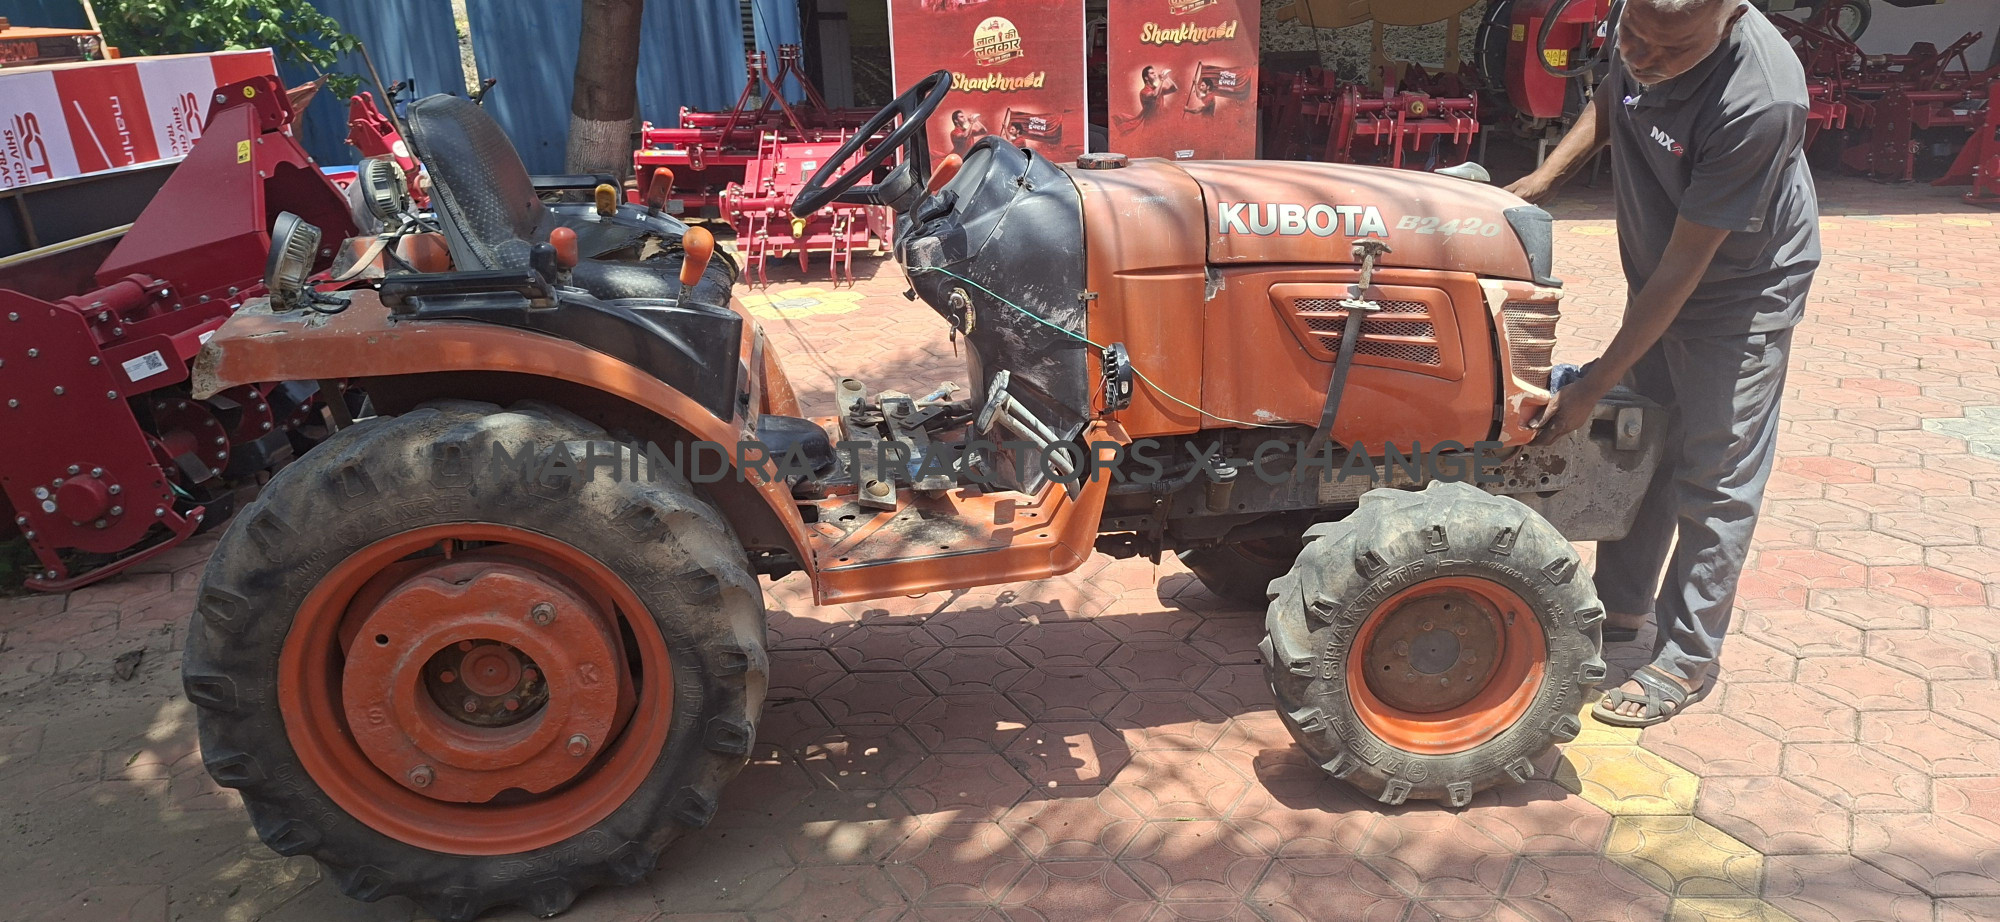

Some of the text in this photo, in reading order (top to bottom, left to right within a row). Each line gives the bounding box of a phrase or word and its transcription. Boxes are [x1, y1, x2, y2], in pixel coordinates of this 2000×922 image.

[975, 38, 1020, 56] ललकार
[172, 106, 184, 131] SHIV
[3, 129, 20, 159] SHIV
[14, 112, 54, 179] SCT
[1218, 202, 1500, 238] KUBOTA B2420
[1551, 679, 1571, 712] NYLON
